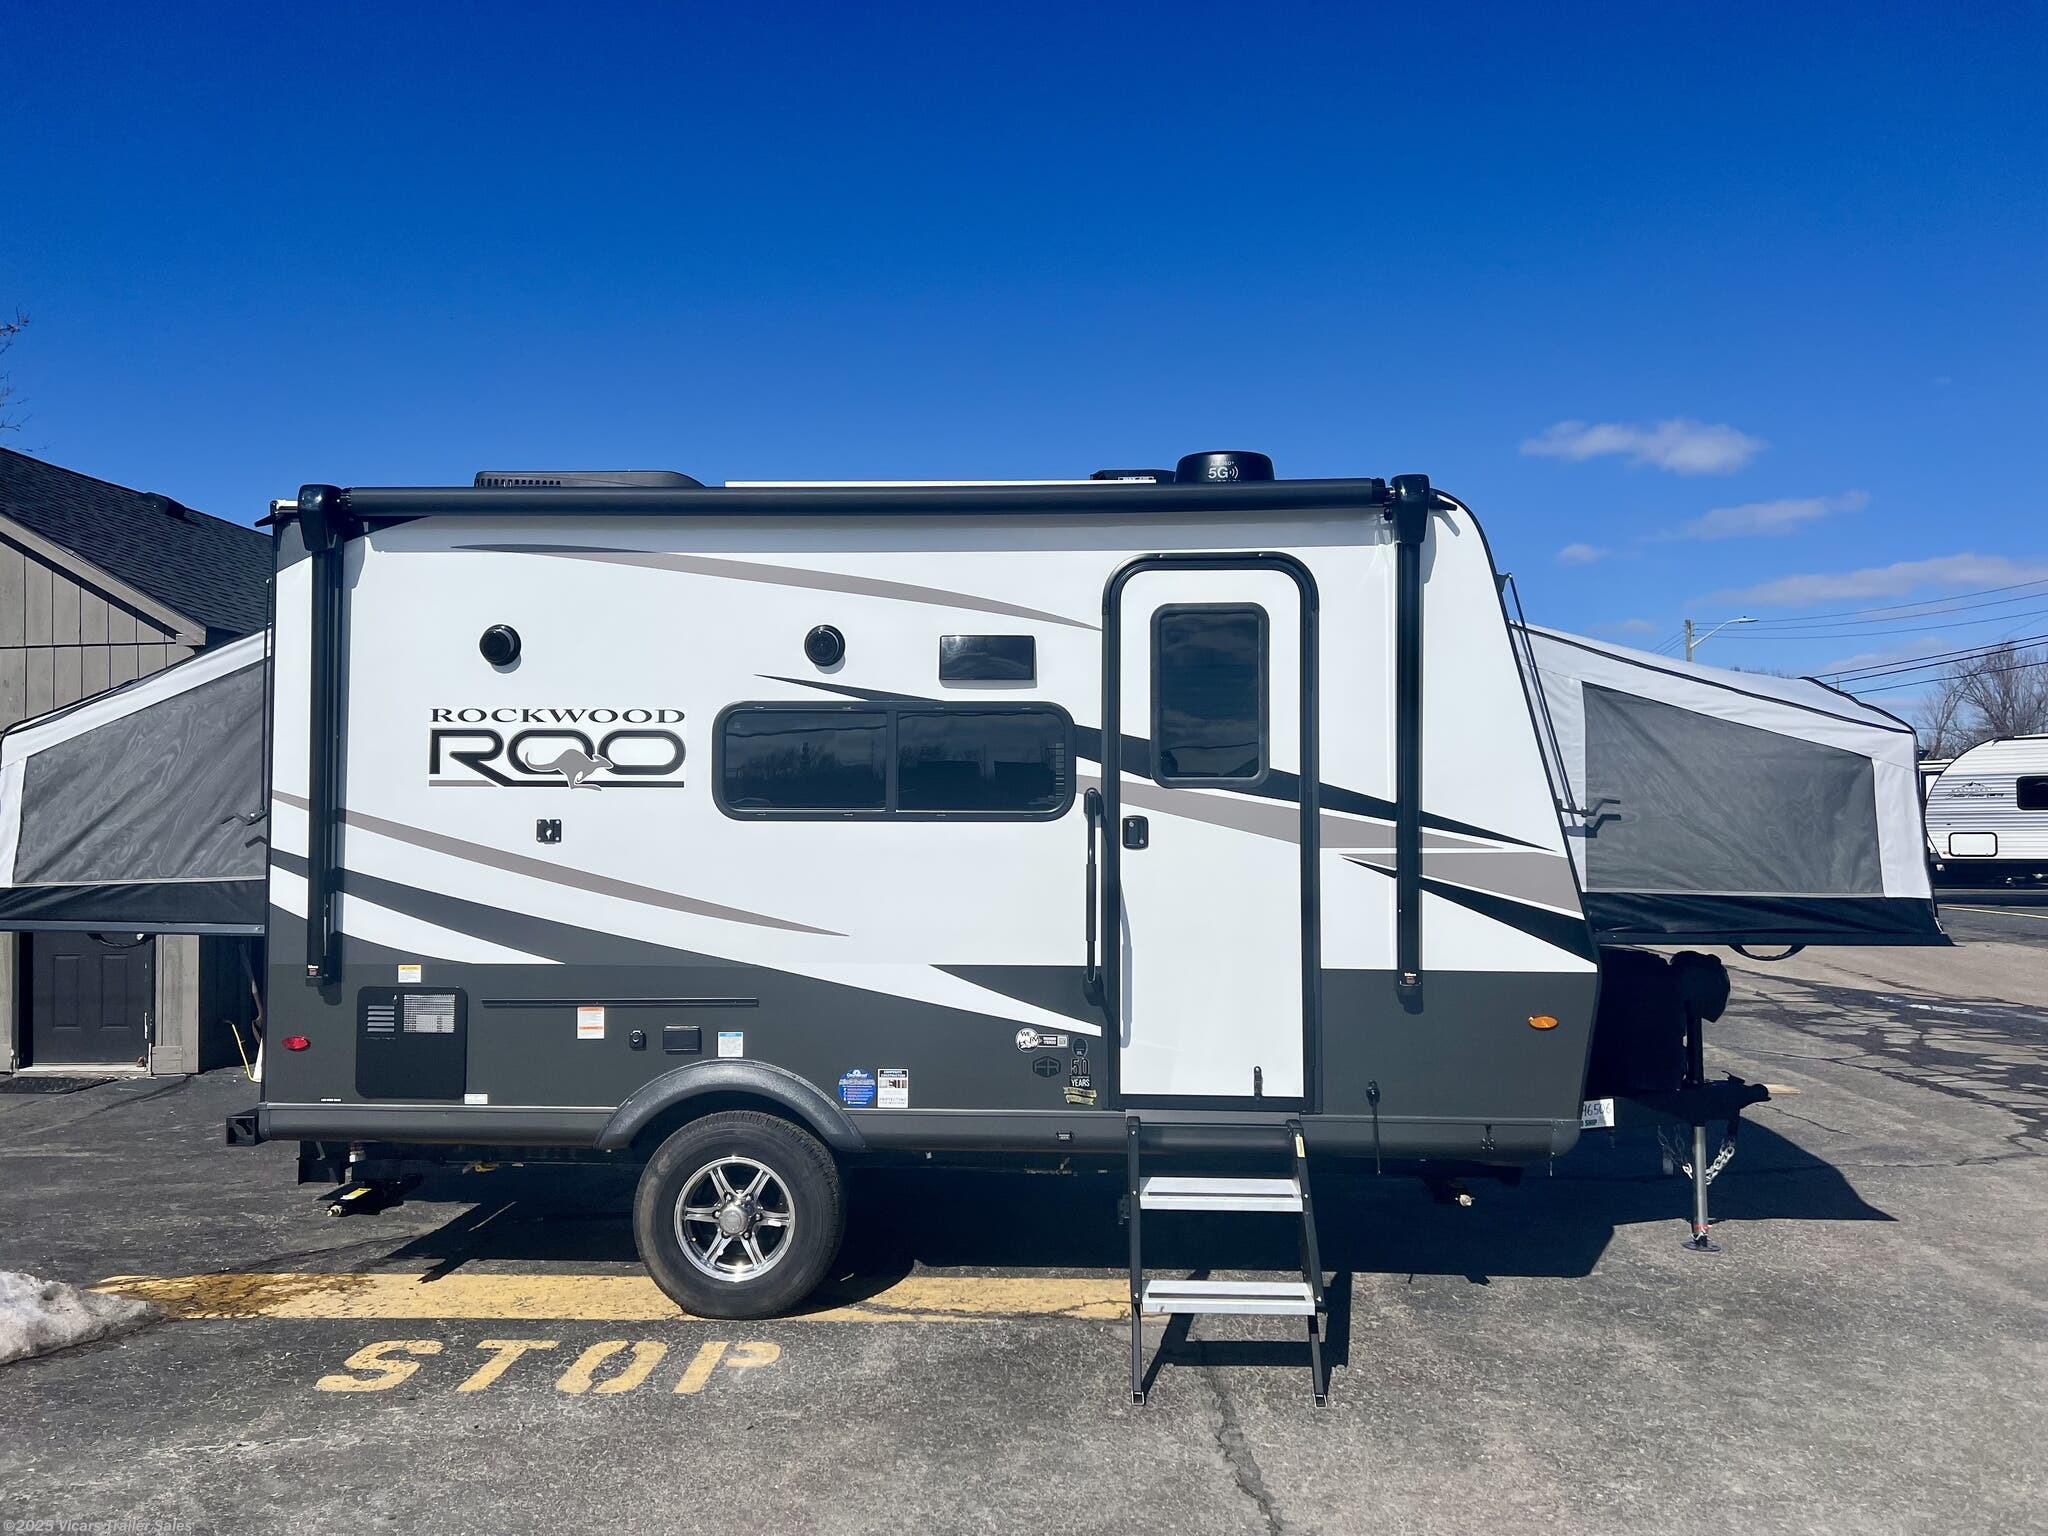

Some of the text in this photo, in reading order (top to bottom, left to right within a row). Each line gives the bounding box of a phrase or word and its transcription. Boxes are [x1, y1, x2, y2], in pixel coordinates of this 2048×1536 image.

[1208, 466, 1228, 479] 5G
[429, 707, 686, 723] ROCKWOOD
[428, 727, 687, 787] ROO
[1071, 1058, 1090, 1075] 50
[1071, 1079, 1090, 1087] YEARS
[314, 1339, 782, 1394] STOP
